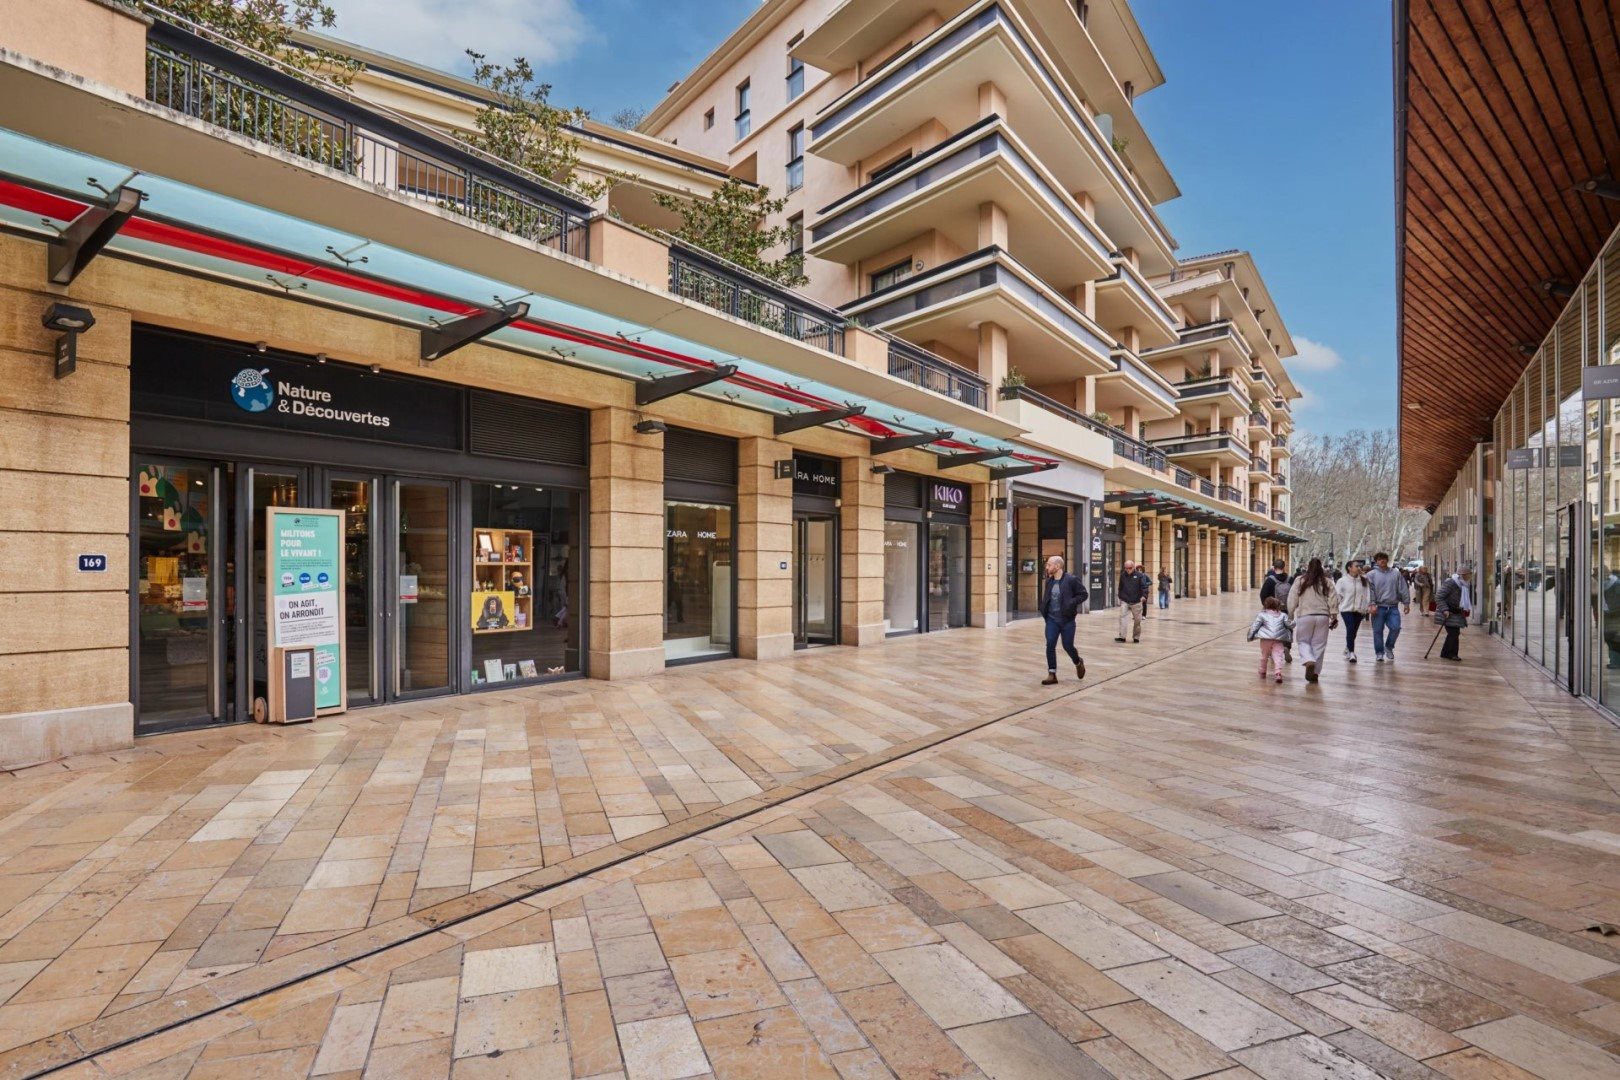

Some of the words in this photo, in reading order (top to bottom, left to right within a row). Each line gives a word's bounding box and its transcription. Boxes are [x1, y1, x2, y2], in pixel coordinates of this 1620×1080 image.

[278, 381, 332, 402] Nature
[277, 399, 290, 413] &
[292, 400, 390, 426] Découvertes
[795, 471, 809, 481] RA
[812, 474, 836, 484] HOME
[934, 484, 963, 504] KIKO
[280, 530, 314, 538] MILITONS
[290, 549, 317, 557] VIVANT
[84, 558, 101, 567] 169
[289, 600, 298, 608] ON
[301, 599, 318, 607] AGIT,
[280, 612, 290, 620] ON
[292, 608, 324, 618] ARRONDIT
